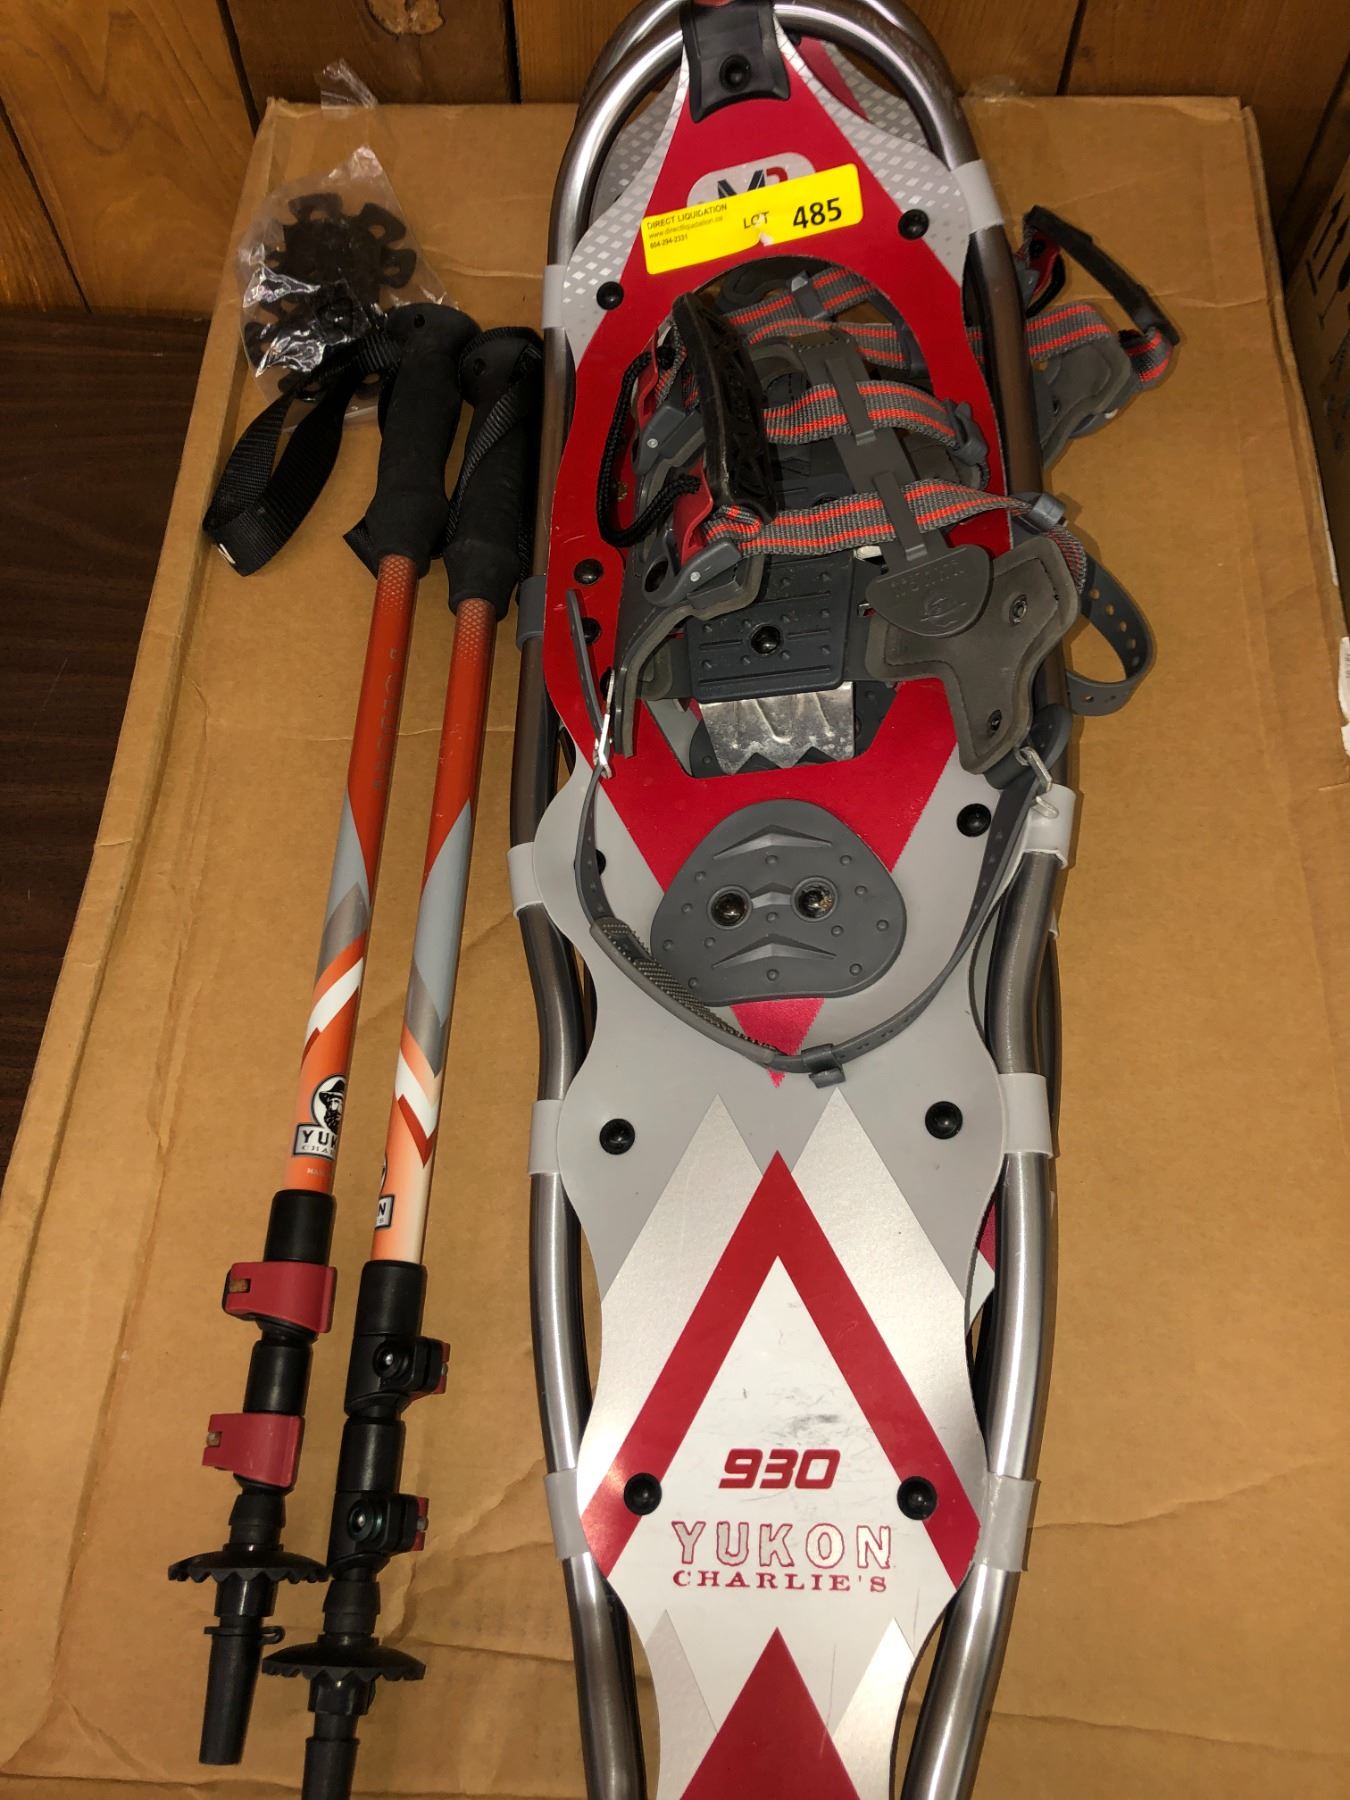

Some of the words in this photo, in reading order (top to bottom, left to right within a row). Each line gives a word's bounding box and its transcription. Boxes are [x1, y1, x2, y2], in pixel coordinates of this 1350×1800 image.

[646, 214, 676, 230] DIRECT
[677, 202, 728, 224] LIQUIDATION
[743, 210, 770, 230] LOT
[792, 197, 842, 230] 485
[717, 1448, 841, 1490] 930
[671, 1520, 892, 1570] YUKON
[672, 1570, 888, 1593] CHARLIE'S
